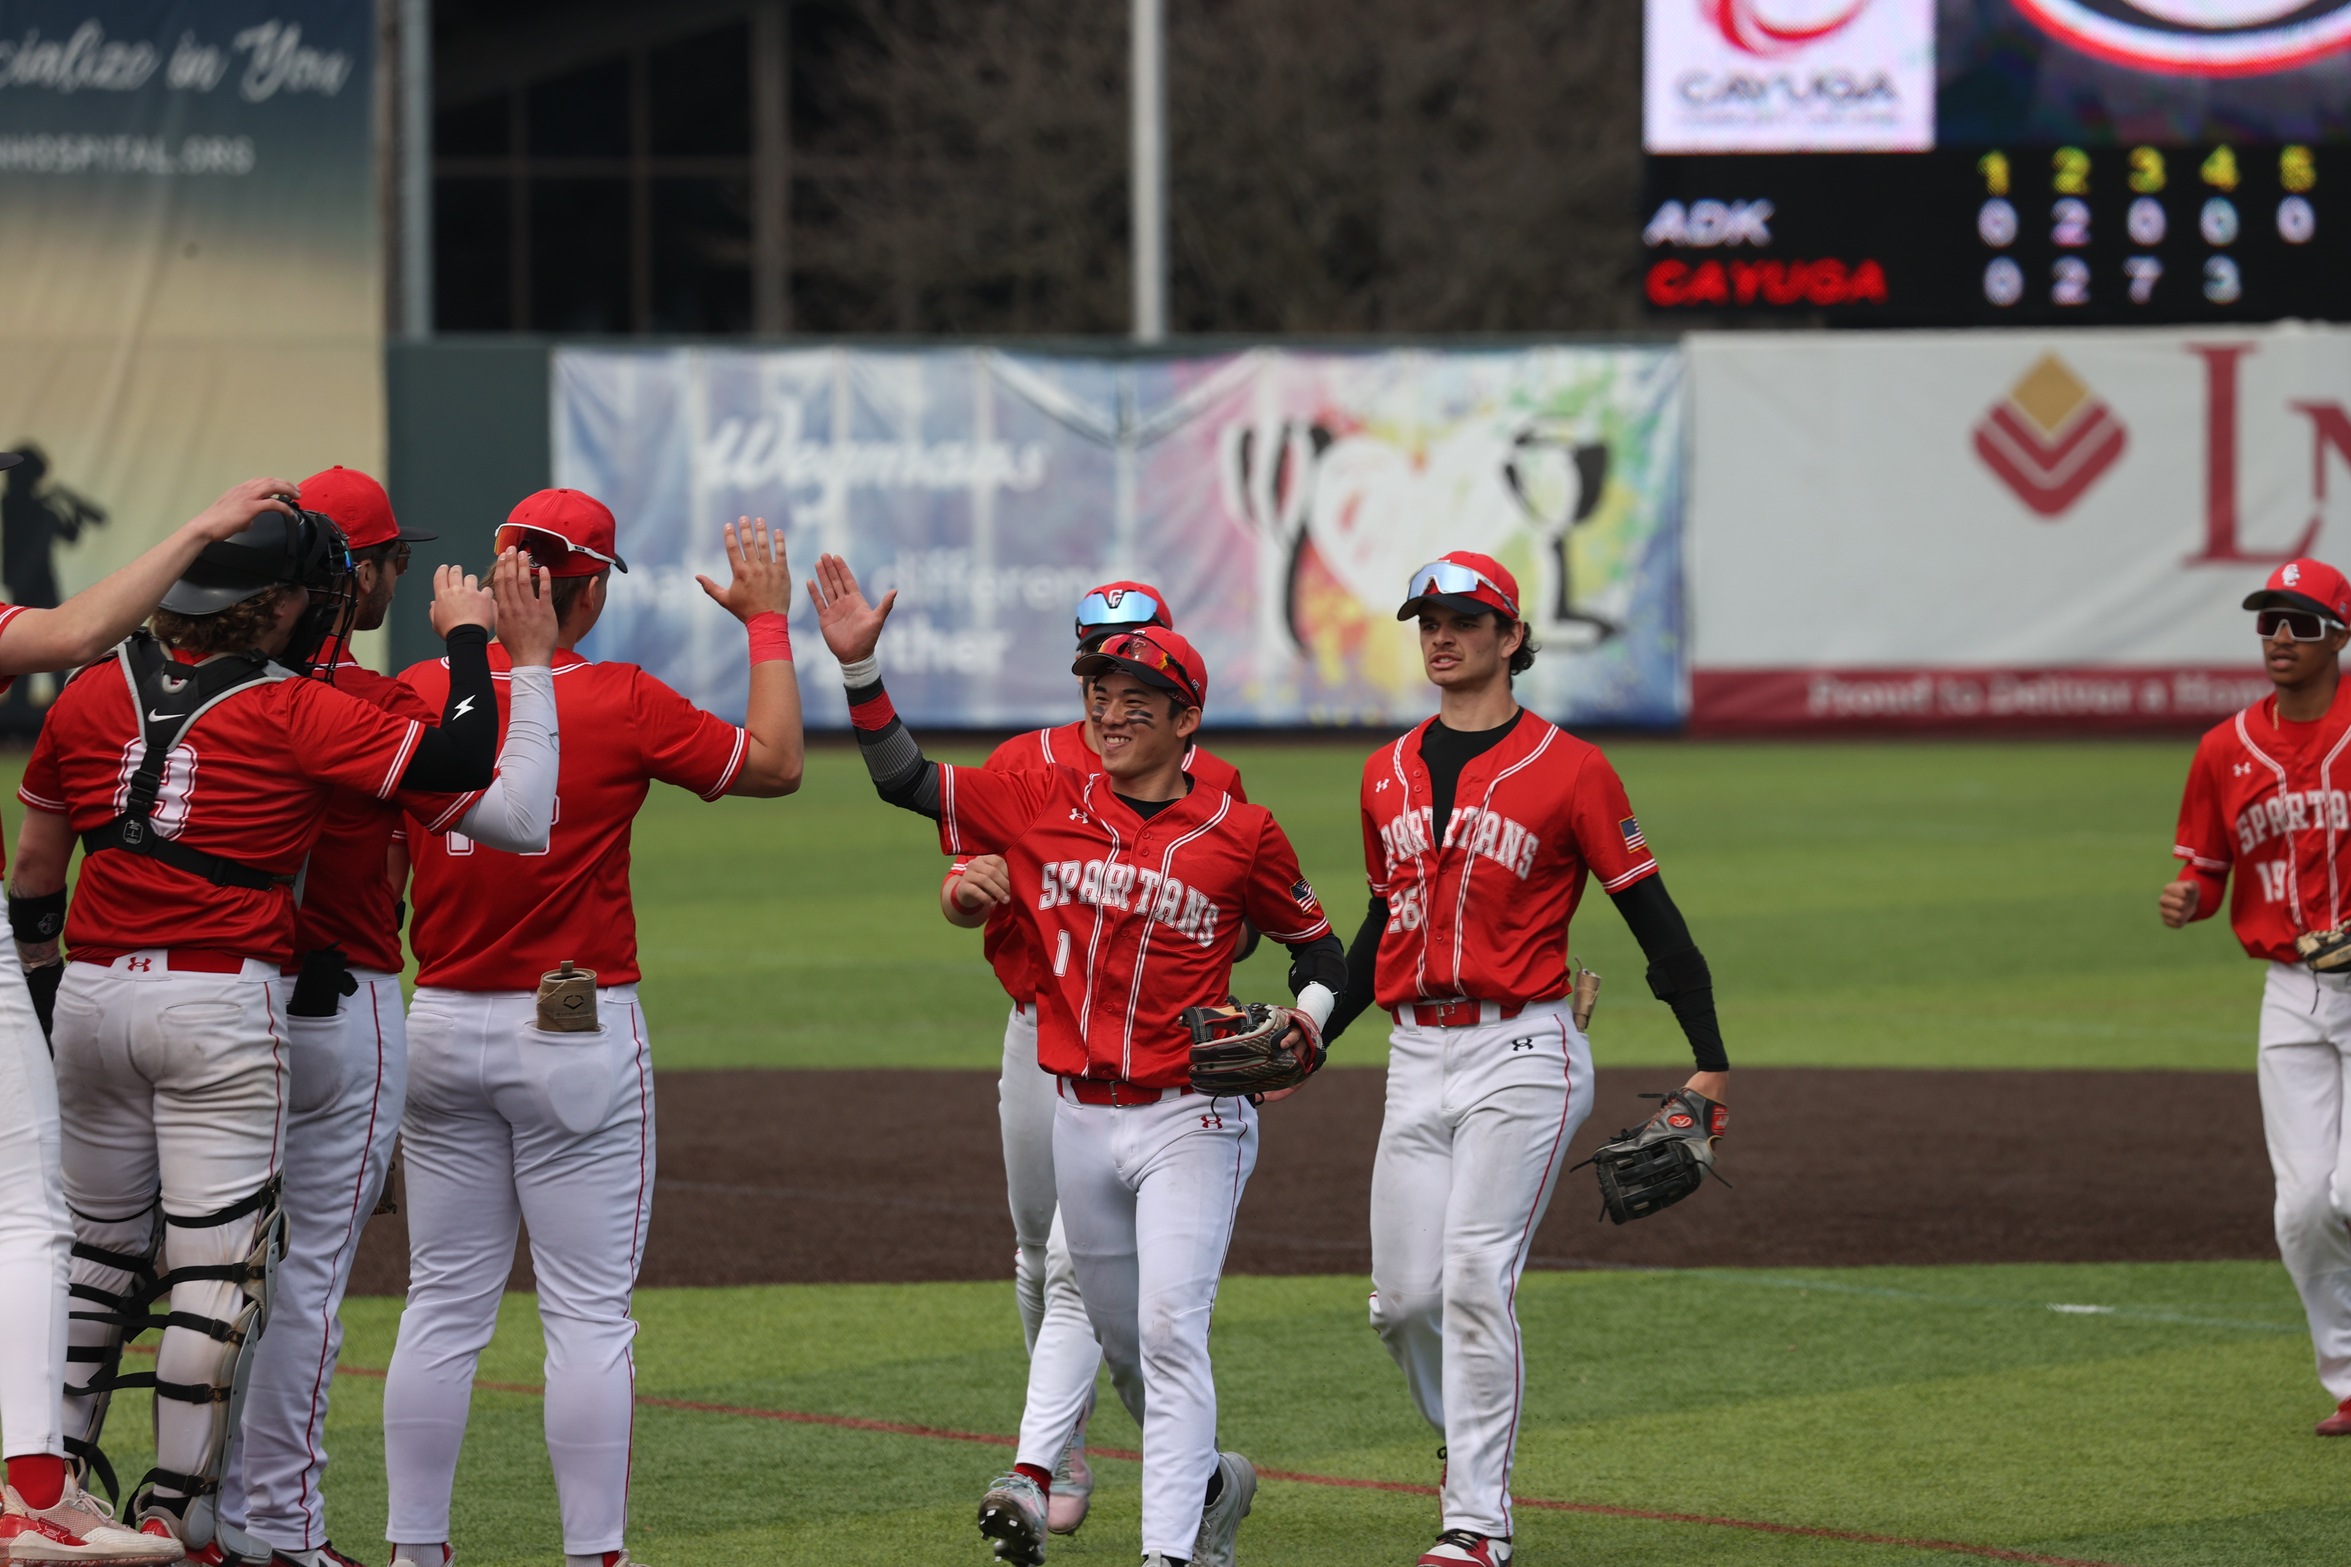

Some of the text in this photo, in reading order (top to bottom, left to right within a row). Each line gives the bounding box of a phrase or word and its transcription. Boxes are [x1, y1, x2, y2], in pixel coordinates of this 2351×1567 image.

[166, 29, 230, 93] in
[233, 17, 353, 103] You
[1977, 149, 2010, 196] 1
[2051, 146, 2091, 195] 2
[2127, 145, 2167, 193] 3
[2200, 143, 2241, 192] 4
[1642, 195, 2315, 247] ADK 0 2 0 0 0
[1645, 253, 2242, 306] CAYUGA 0 2 7 3
[1038, 858, 1221, 948] SPARTANS
[2255, 860, 2288, 903] 19
[1388, 886, 1422, 934] 26
[1053, 929, 1071, 977] 1
